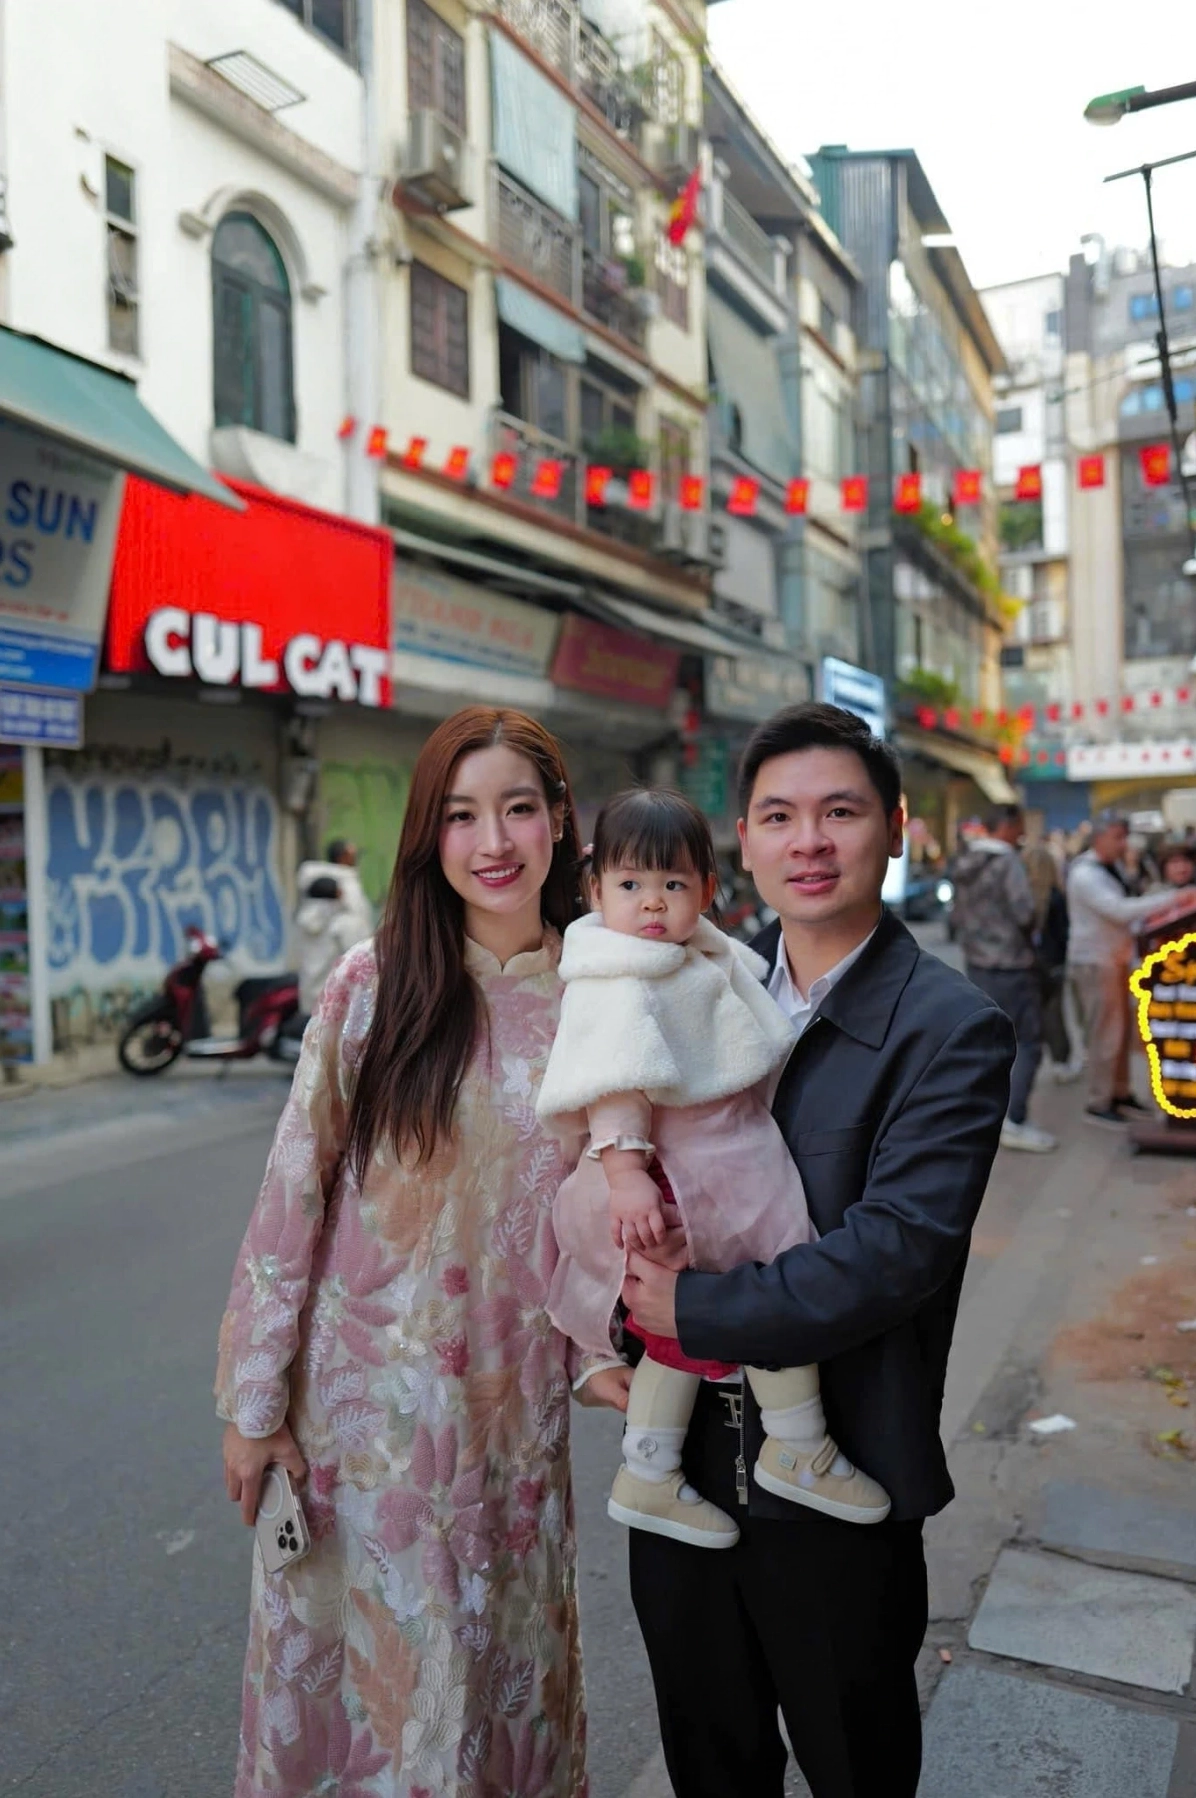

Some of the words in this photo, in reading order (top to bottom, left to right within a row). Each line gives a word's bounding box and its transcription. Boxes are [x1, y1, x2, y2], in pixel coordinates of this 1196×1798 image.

[6, 478, 98, 543] SUN
[0, 537, 35, 589] S
[144, 605, 279, 687] CUL
[283, 632, 388, 708] CAT
